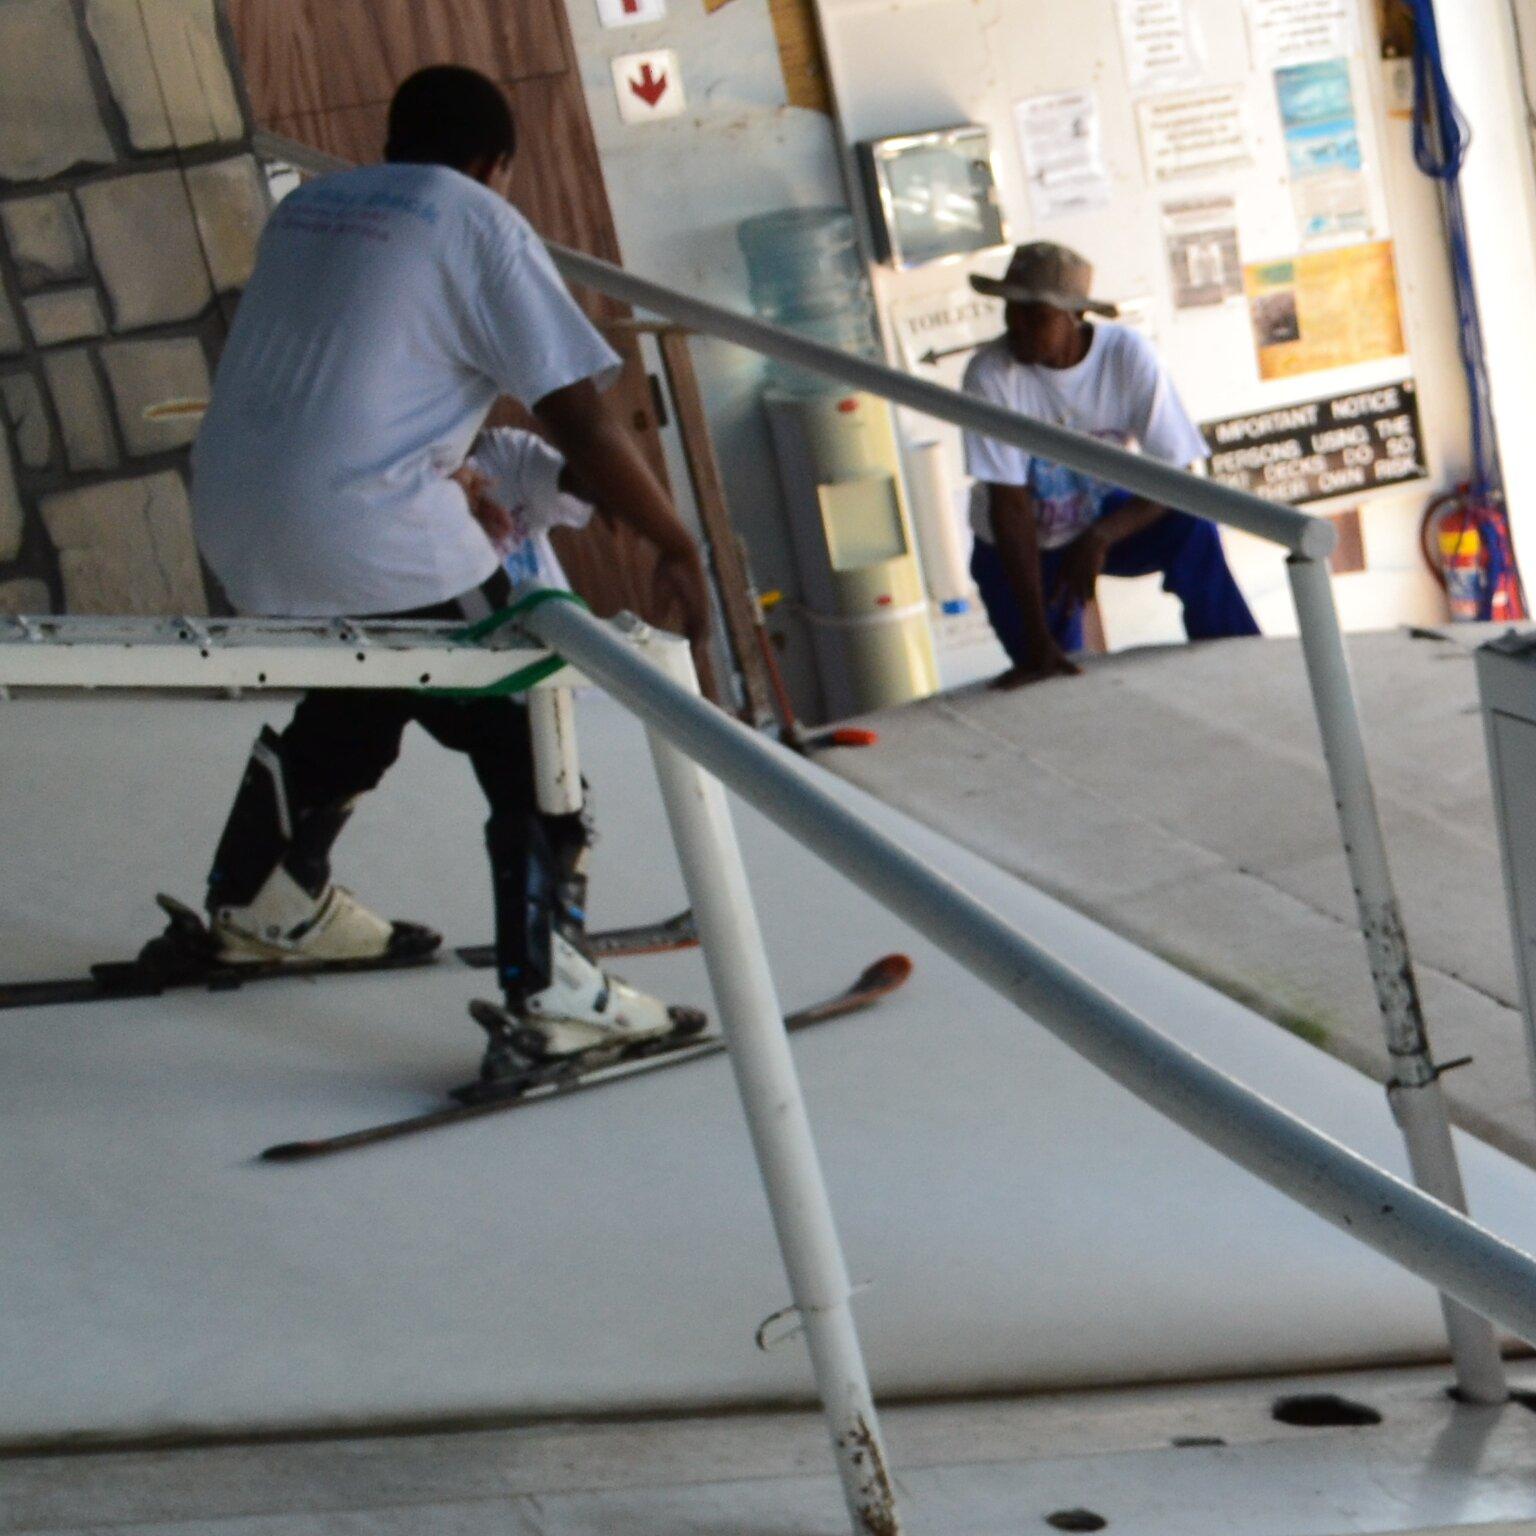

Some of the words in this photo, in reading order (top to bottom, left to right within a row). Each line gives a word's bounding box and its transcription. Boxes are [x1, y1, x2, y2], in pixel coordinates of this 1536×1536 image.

[1215, 403, 1319, 445] IMPORTANT
[1331, 387, 1400, 420] NOTICE
[1211, 438, 1302, 475] PERSONS
[1311, 424, 1371, 454] USING
[1374, 413, 1412, 440] THE
[1264, 453, 1328, 484] DECKS
[1343, 443, 1375, 468] DO
[1386, 434, 1416, 459] SO
[1318, 465, 1366, 494] OWN
[1374, 455, 1419, 480] RISK
